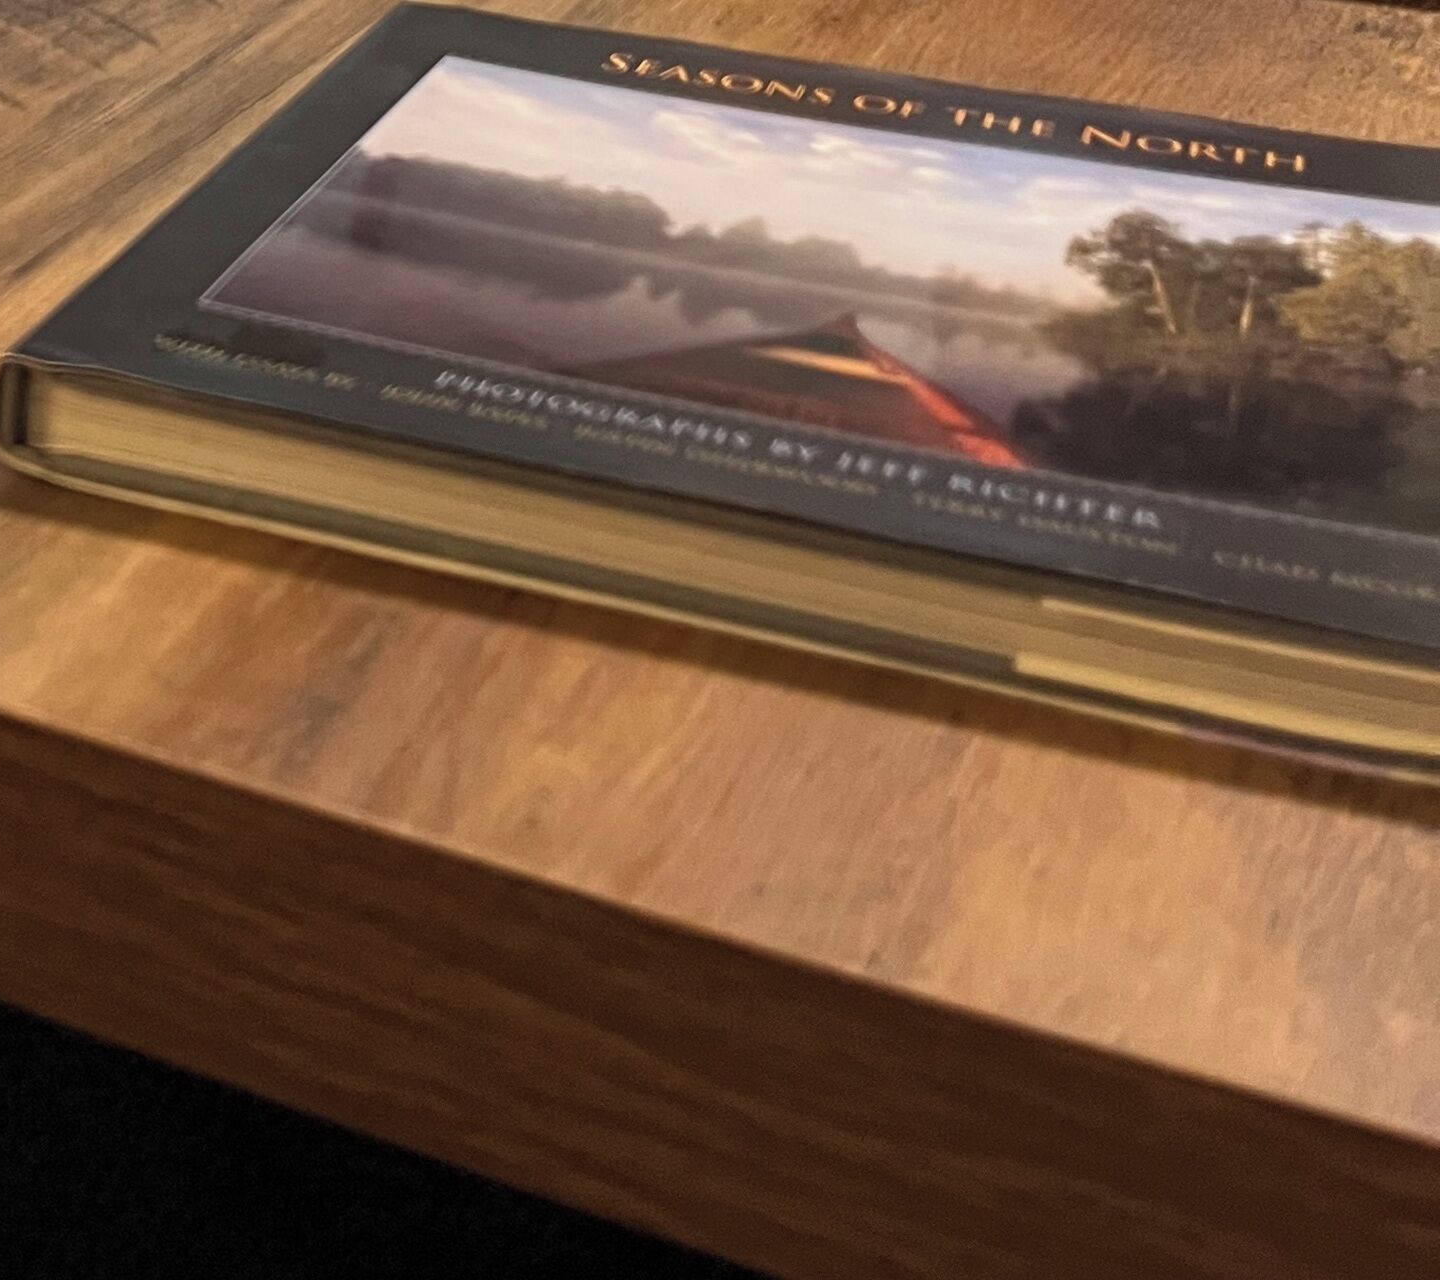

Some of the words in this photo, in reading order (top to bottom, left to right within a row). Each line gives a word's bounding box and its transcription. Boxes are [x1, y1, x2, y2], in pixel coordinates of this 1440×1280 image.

[601, 51, 836, 105] SEASONS
[852, 93, 926, 119] OF
[946, 104, 1057, 139] THE
[1080, 124, 1307, 173] NORTH
[433, 368, 753, 450] PHOTOGRAPHS
[768, 436, 822, 463] BY
[835, 450, 928, 484] JEFF
[946, 471, 1162, 530] RICHTER
